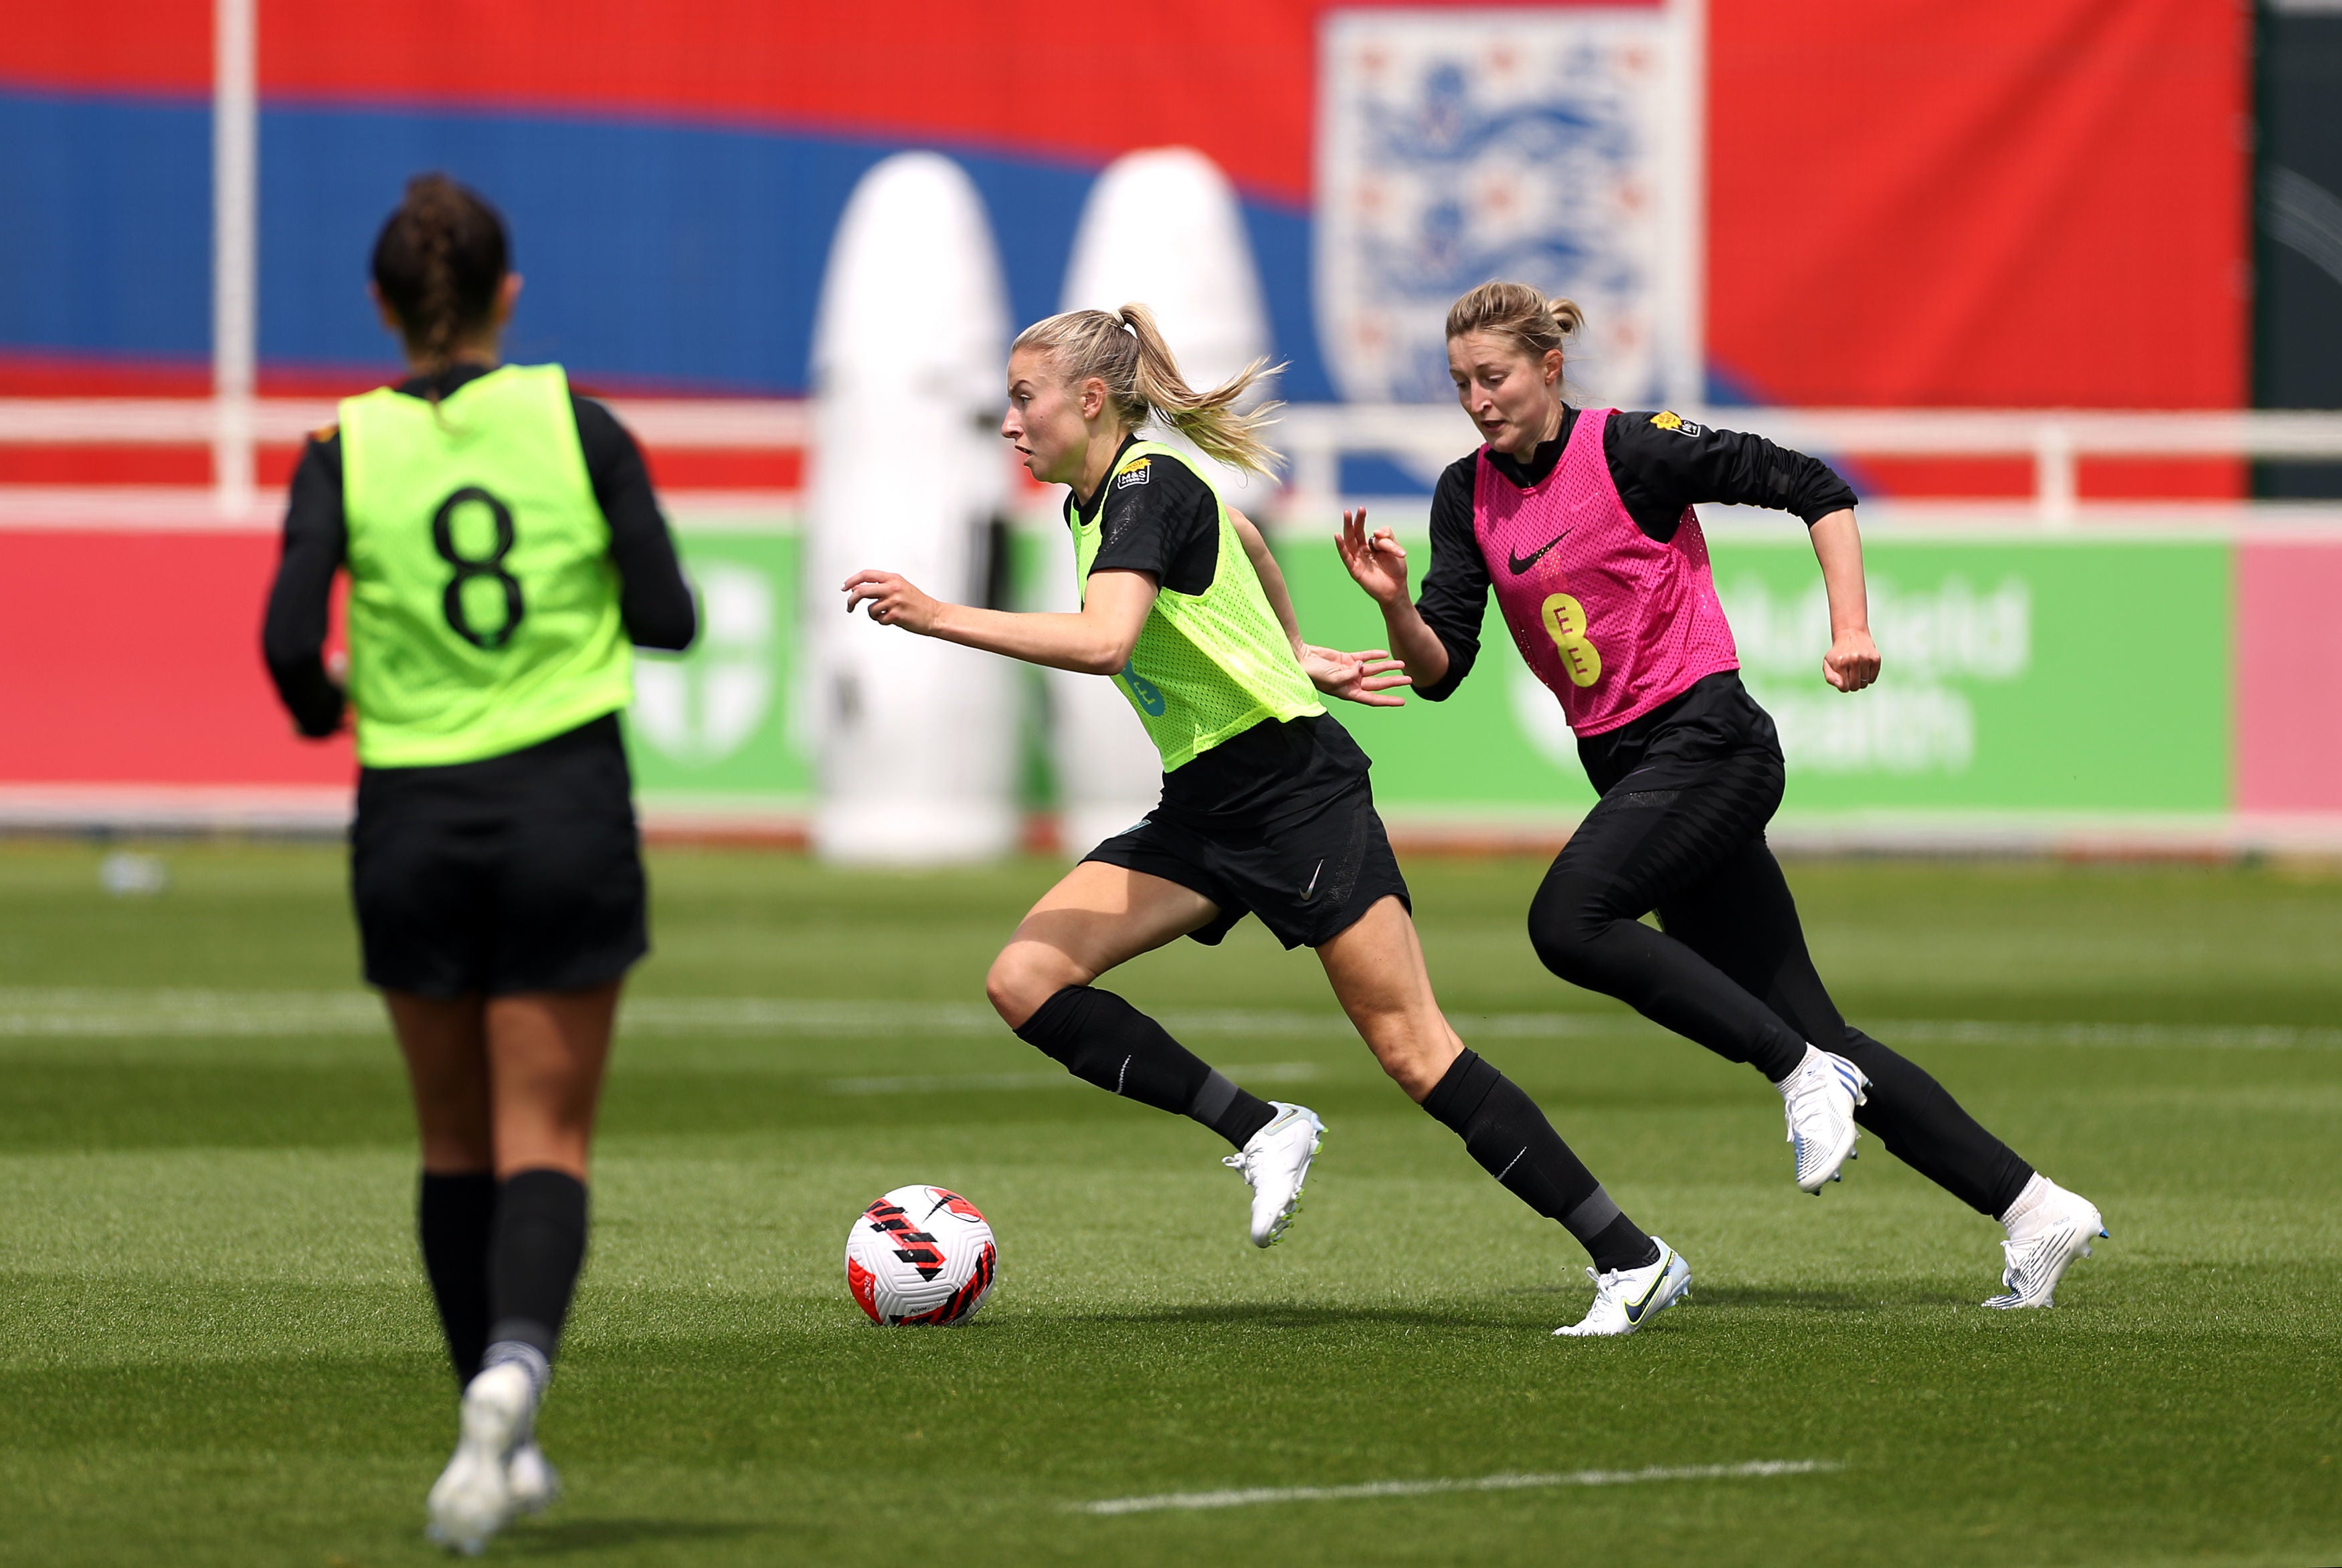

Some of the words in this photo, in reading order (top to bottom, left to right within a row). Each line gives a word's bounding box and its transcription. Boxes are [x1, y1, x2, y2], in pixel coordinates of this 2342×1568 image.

[1121, 471, 1146, 481] M&S
[432, 486, 524, 652] 8
[1763, 684, 1974, 773] ealth
